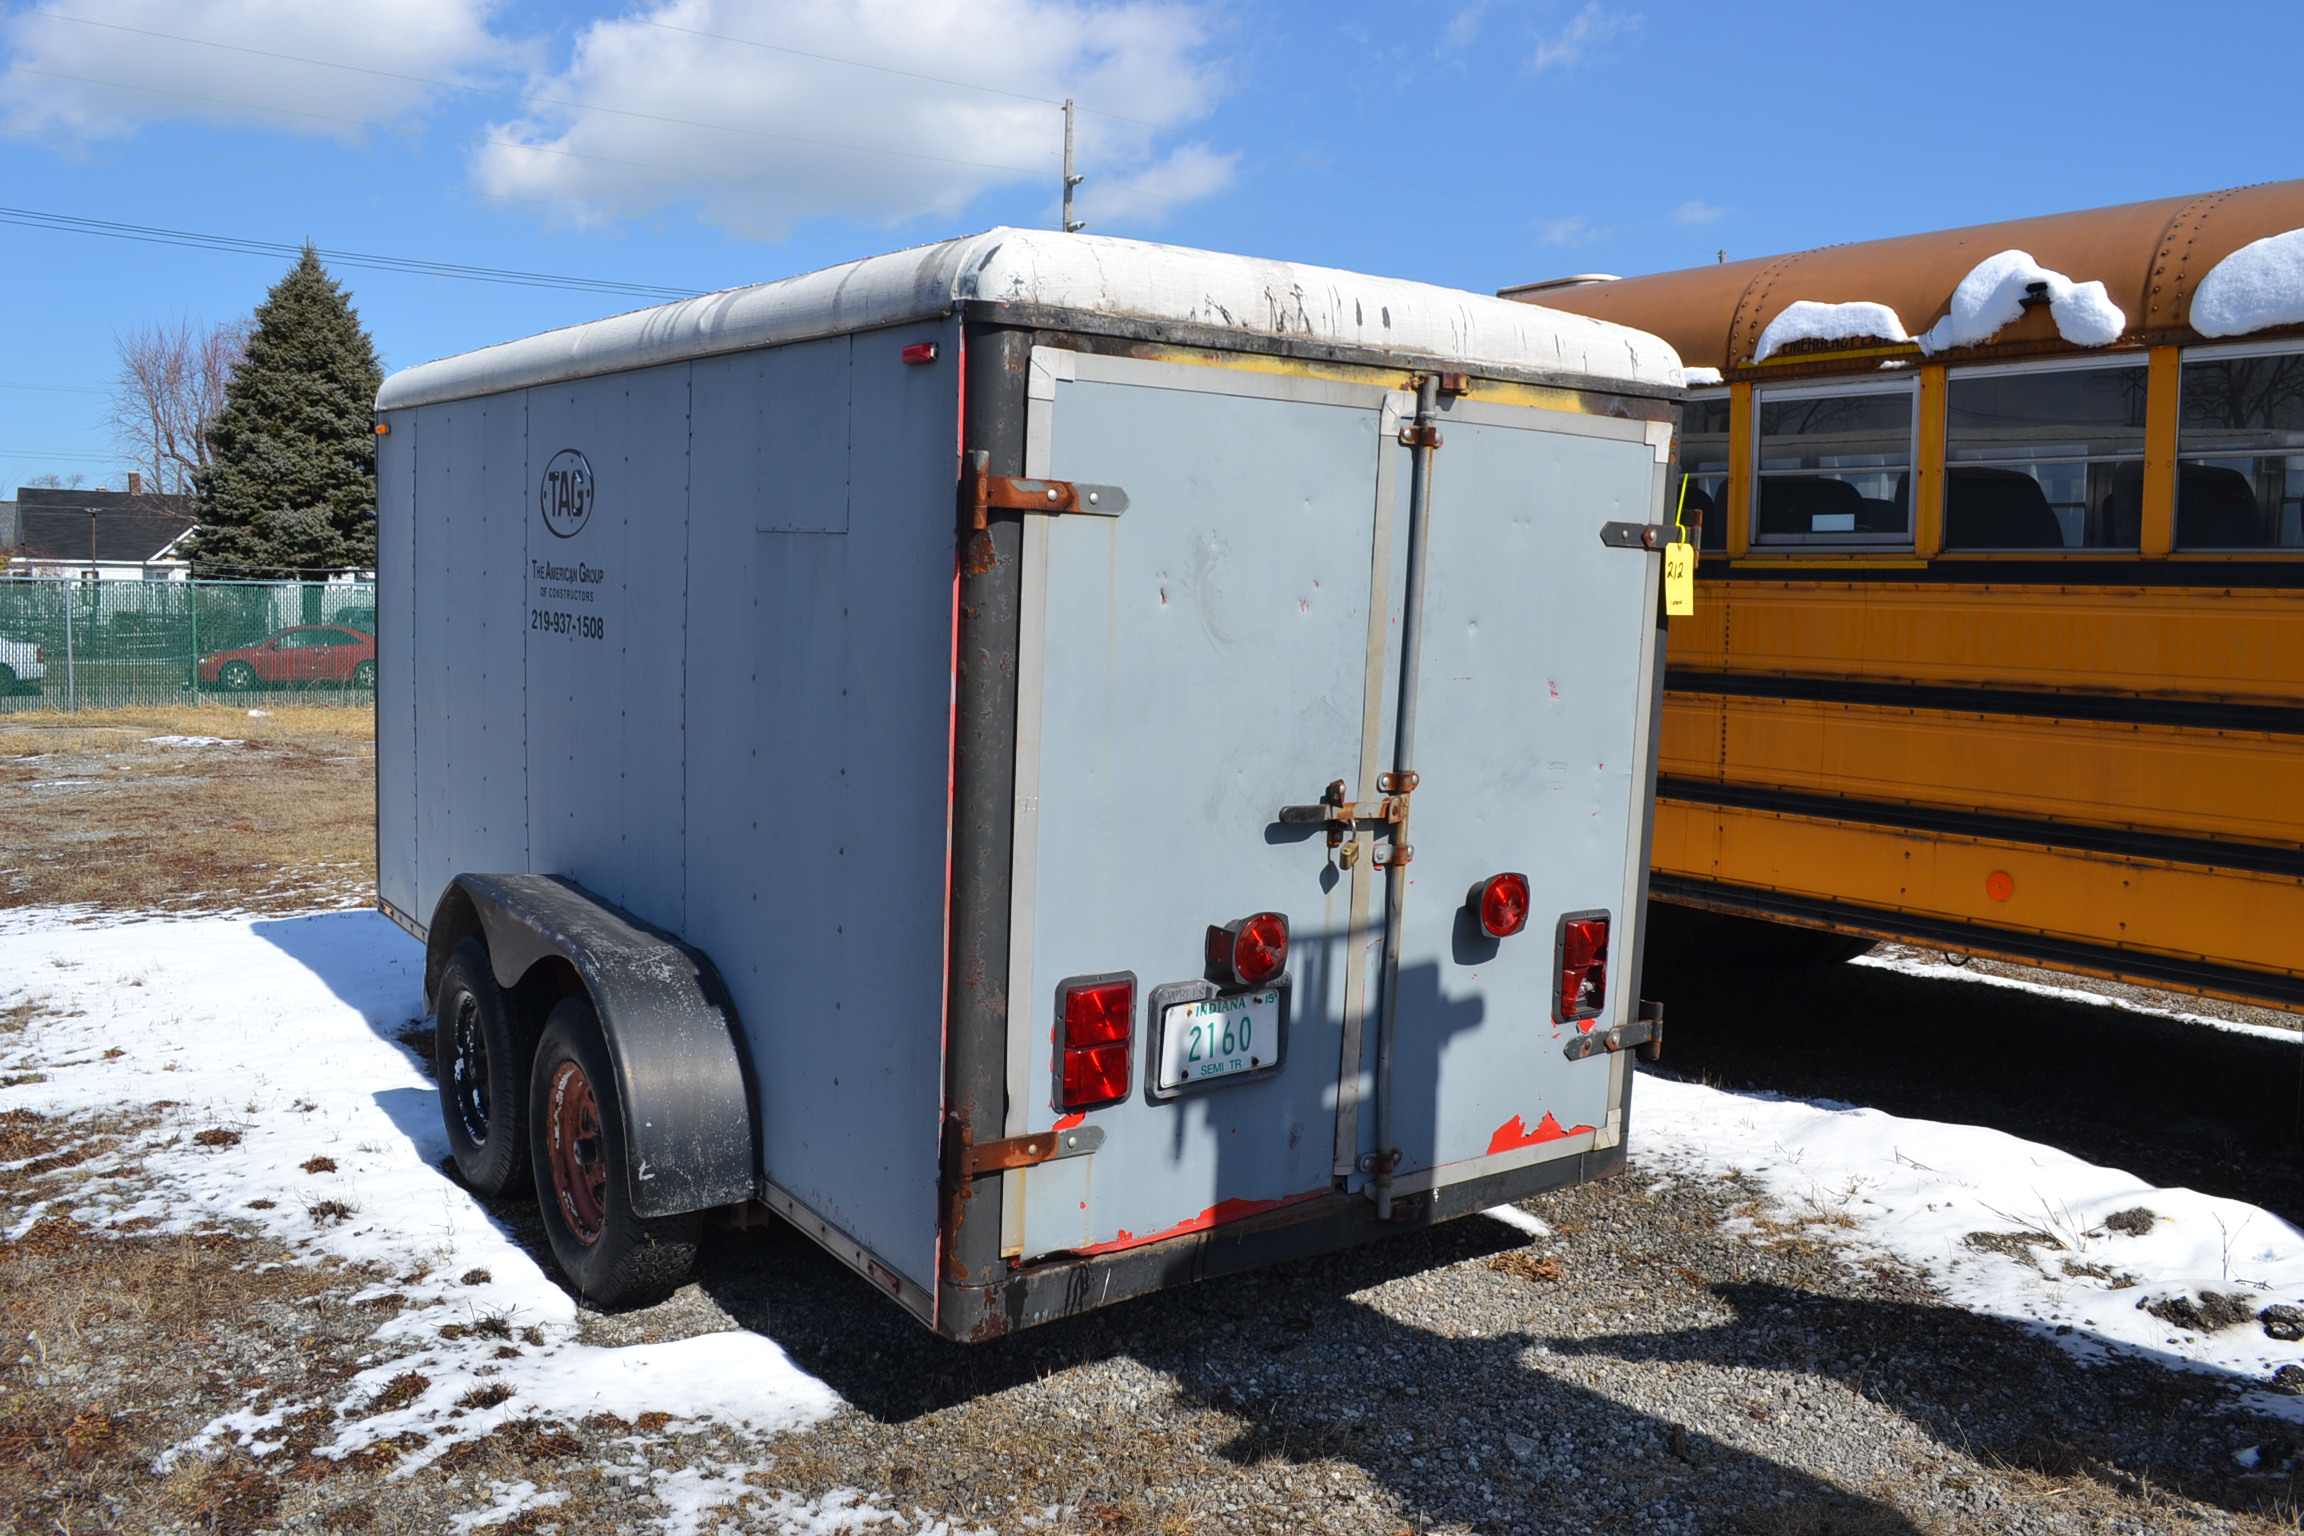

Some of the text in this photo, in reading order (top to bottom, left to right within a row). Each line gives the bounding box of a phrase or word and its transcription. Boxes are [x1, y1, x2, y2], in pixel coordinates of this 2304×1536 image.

[548, 469, 583, 517] TAG
[540, 586, 594, 602] OF CONSTRUCTORS
[531, 608, 604, 640] 219-937-1508
[1195, 996, 1246, 1018] INDIANA
[1188, 1016, 1252, 1063] 2160
[1200, 1058, 1242, 1076] SEMI TR
